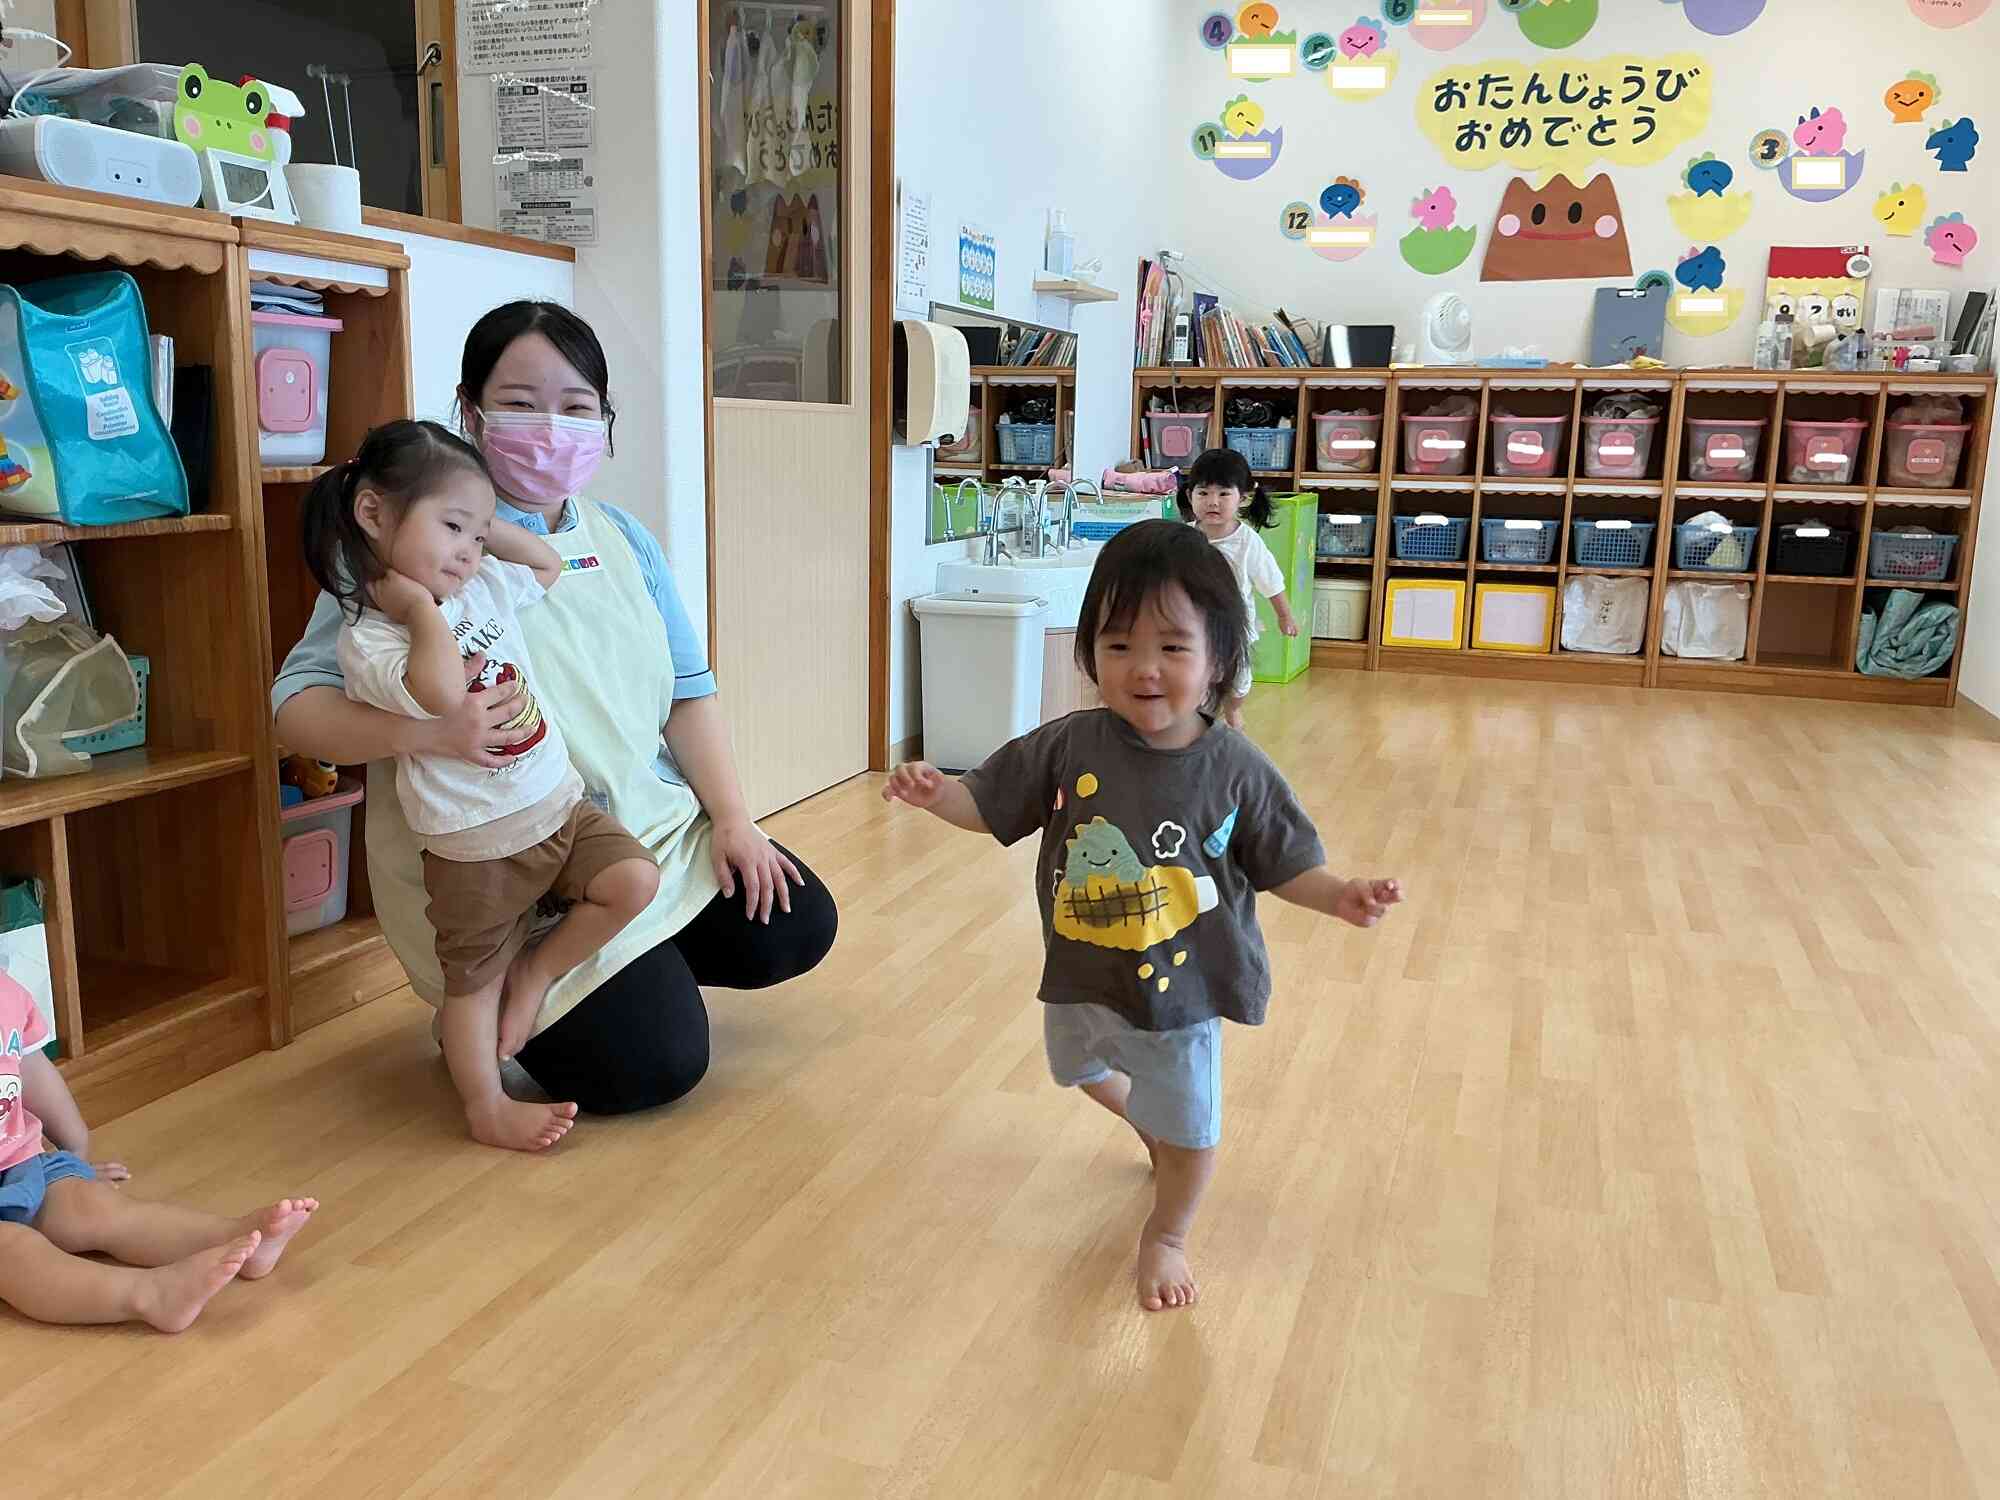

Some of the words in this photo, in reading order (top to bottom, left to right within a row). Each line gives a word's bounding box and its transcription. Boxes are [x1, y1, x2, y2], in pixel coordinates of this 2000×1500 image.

[1208, 20, 1224, 41] 4
[1434, 65, 1700, 113] おたんじょうび
[1455, 106, 1655, 151] おめでとう
[1198, 130, 1216, 152] 11
[1760, 138, 1780, 160] 3
[1288, 212, 1309, 229] 12
[452, 616, 474, 641] RRY
